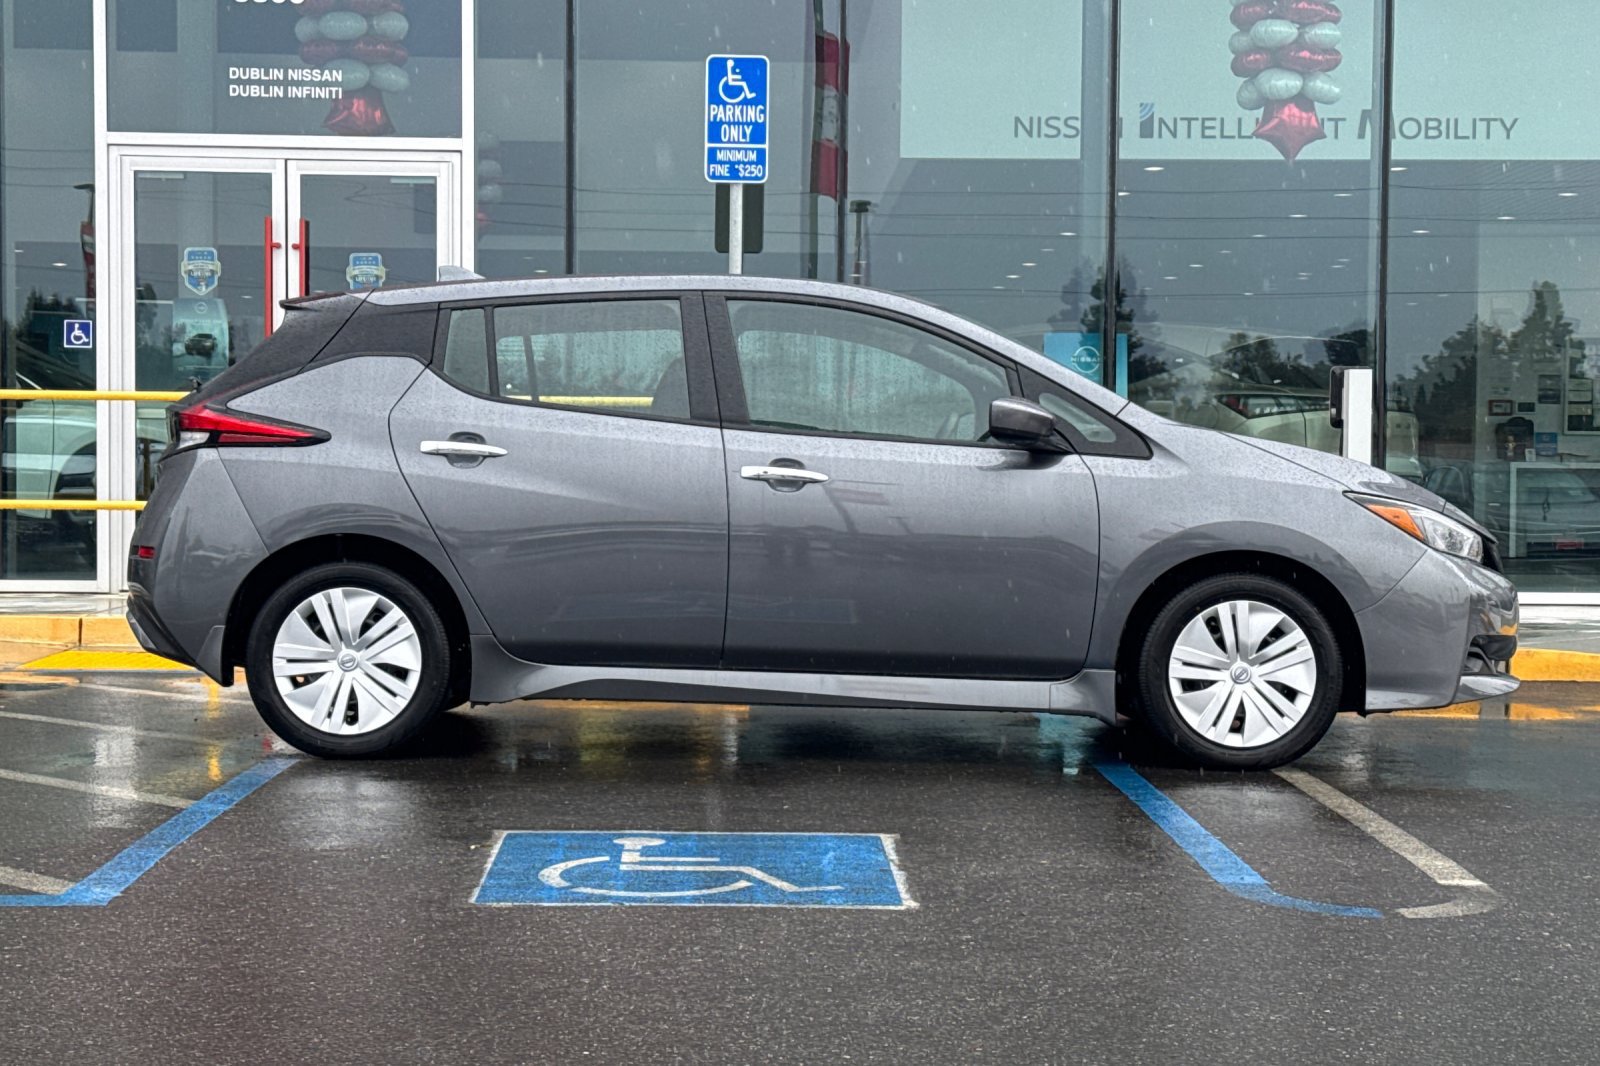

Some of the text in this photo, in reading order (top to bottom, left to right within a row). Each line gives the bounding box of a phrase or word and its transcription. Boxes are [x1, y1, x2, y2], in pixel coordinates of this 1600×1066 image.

[229, 67, 343, 82] DUBLIN NISSAN
[229, 85, 343, 99] DUBLIN INFINITI
[709, 104, 765, 123] PARKING
[720, 124, 753, 142] ONLY
[1013, 116, 1123, 139] NISS
[716, 149, 757, 162] MINIMUM
[709, 164, 731, 177] FINE
